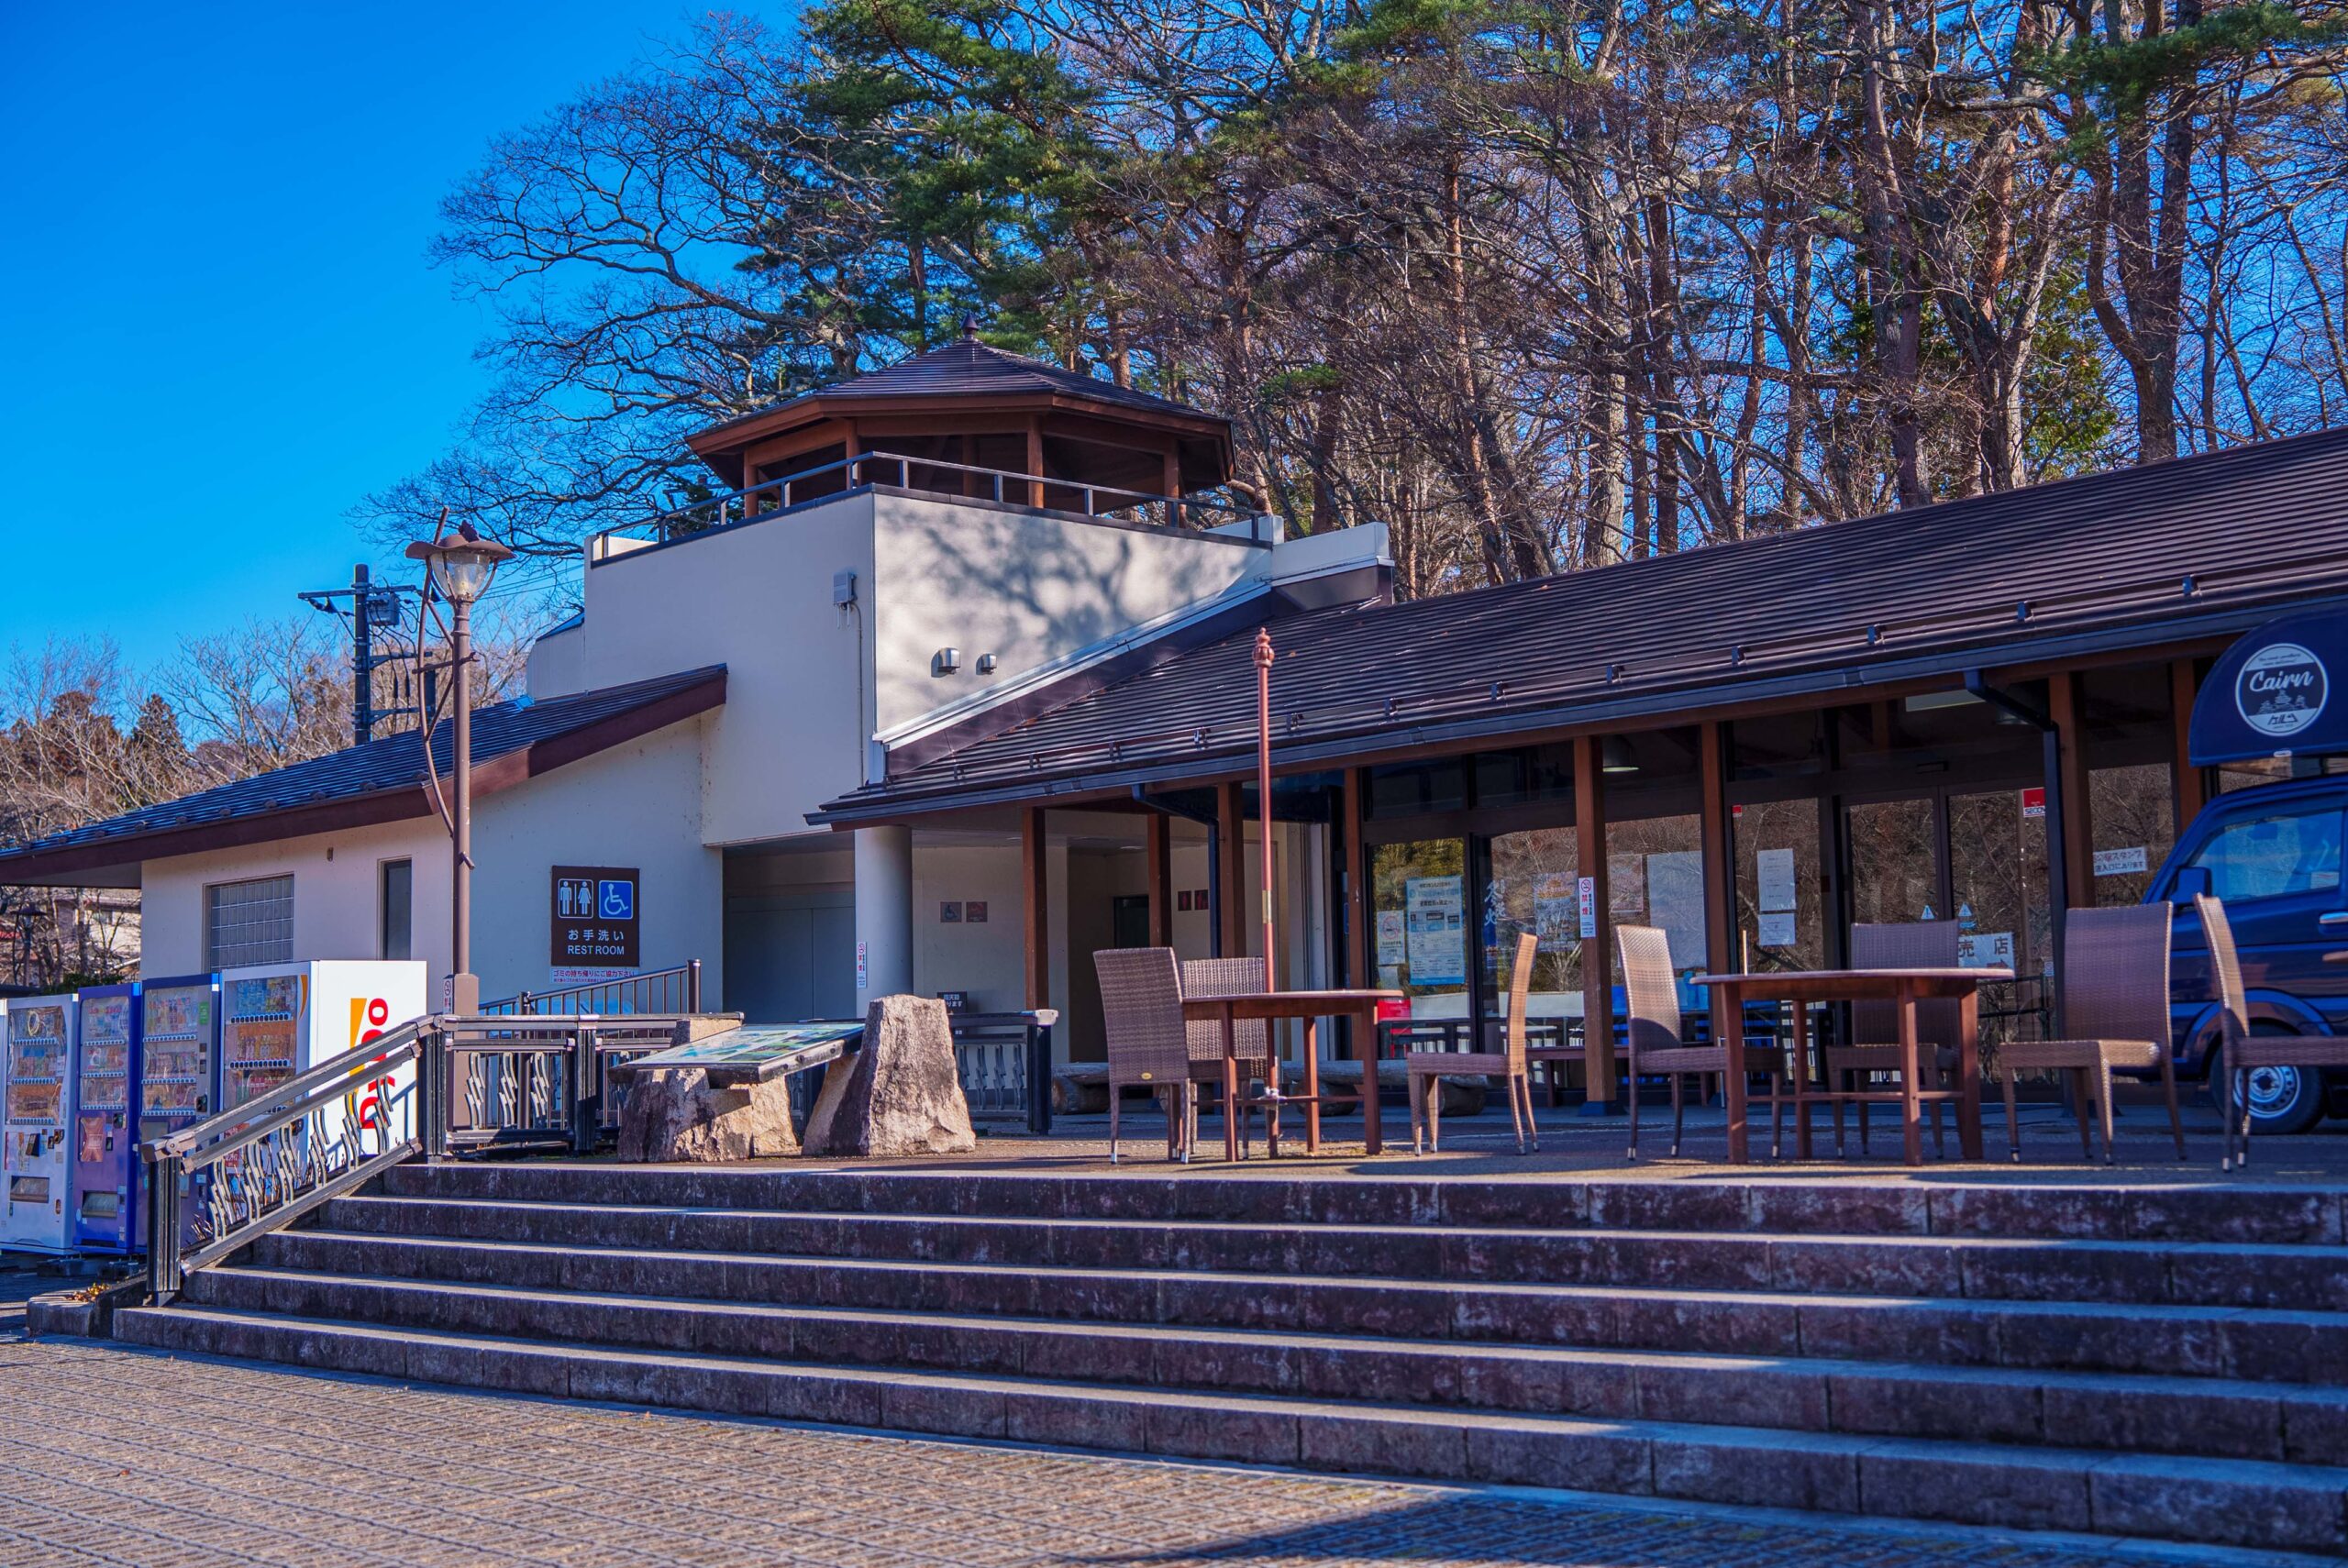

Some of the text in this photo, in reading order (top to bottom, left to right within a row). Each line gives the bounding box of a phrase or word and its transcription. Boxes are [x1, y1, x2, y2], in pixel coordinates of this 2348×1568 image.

[2249, 670, 2314, 692] Cairn
[568, 929, 624, 941] お手洗い
[568, 945, 625, 955] REST ROOM
[1958, 936, 2009, 957] 売店
